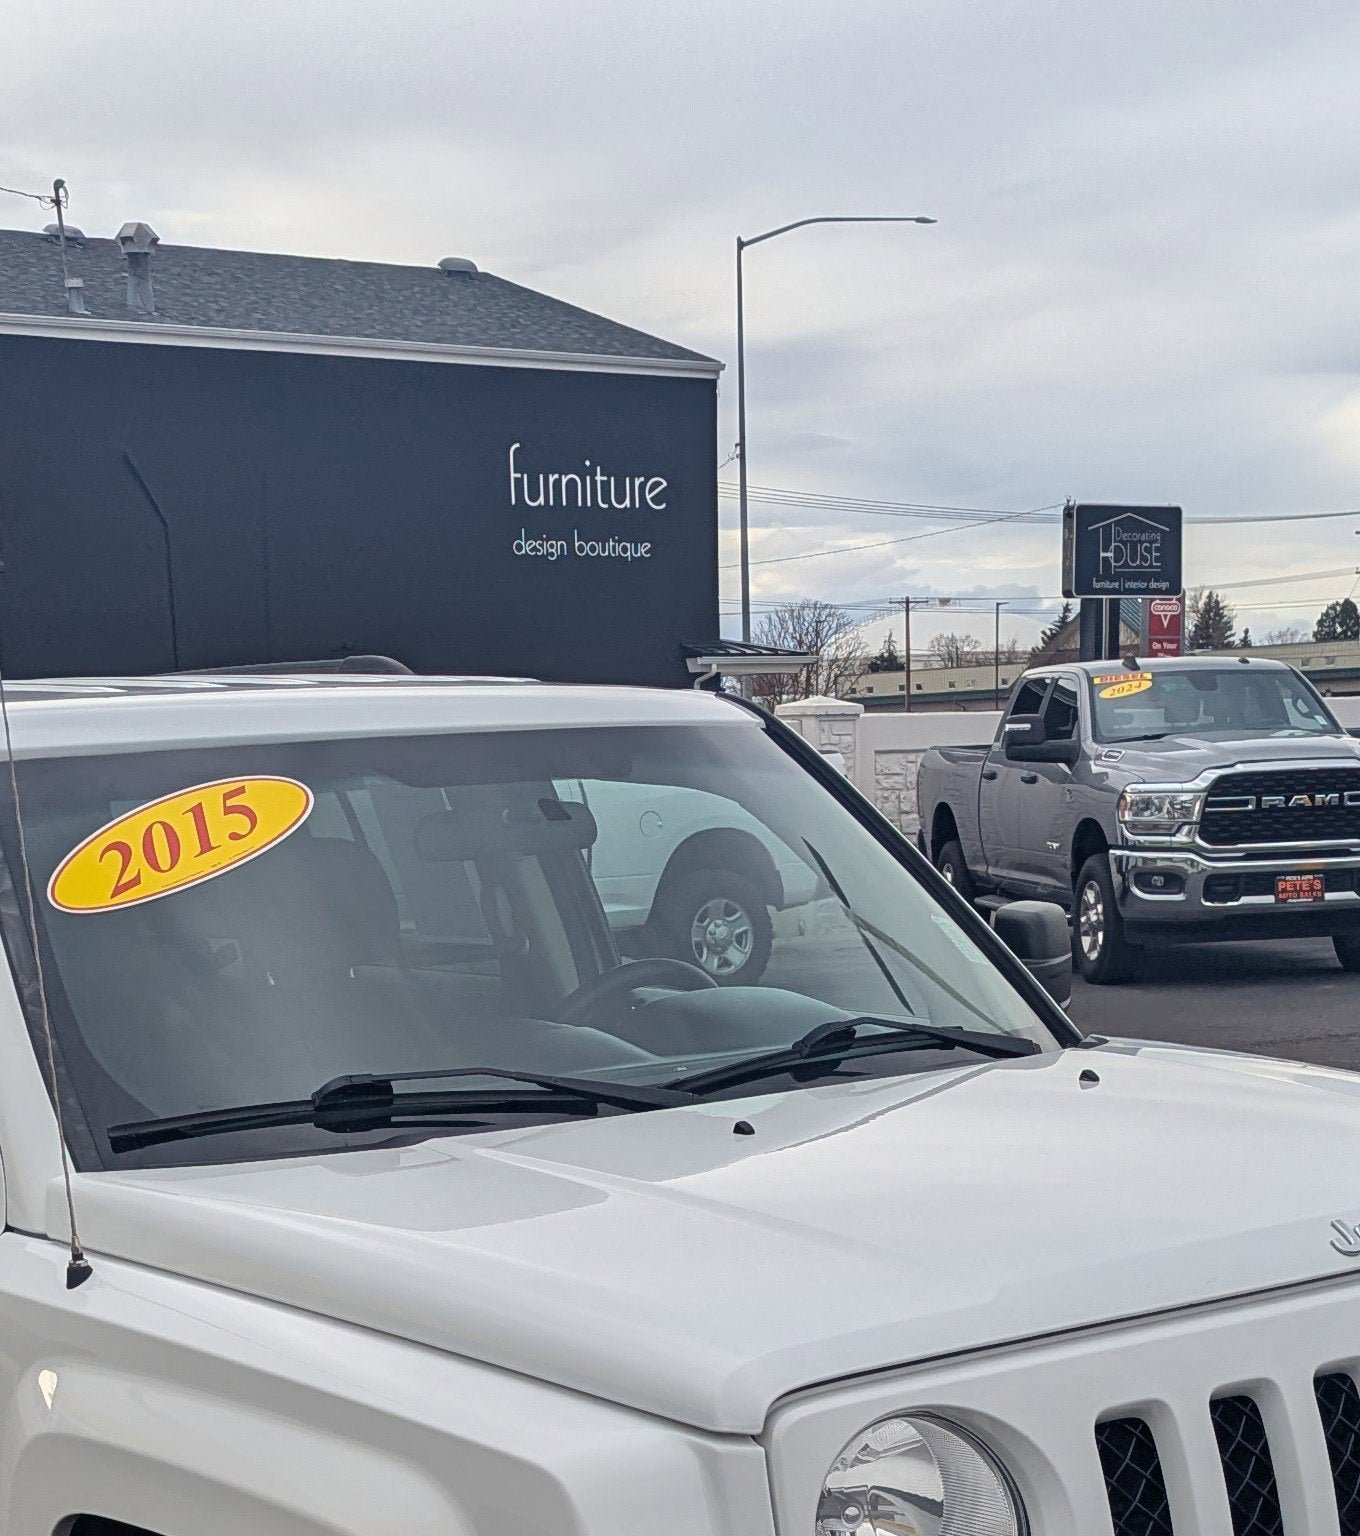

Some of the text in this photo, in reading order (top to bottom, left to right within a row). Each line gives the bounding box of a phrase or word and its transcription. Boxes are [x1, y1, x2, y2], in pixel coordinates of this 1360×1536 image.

[509, 442, 668, 510] furniture
[512, 528, 652, 561] design boutique
[1115, 527, 1161, 545] Decorating
[1093, 577, 1170, 591] furniture interior design
[1261, 794, 1339, 808] RAM
[99, 784, 259, 899] 2015
[1278, 880, 1322, 891] PETE'S
